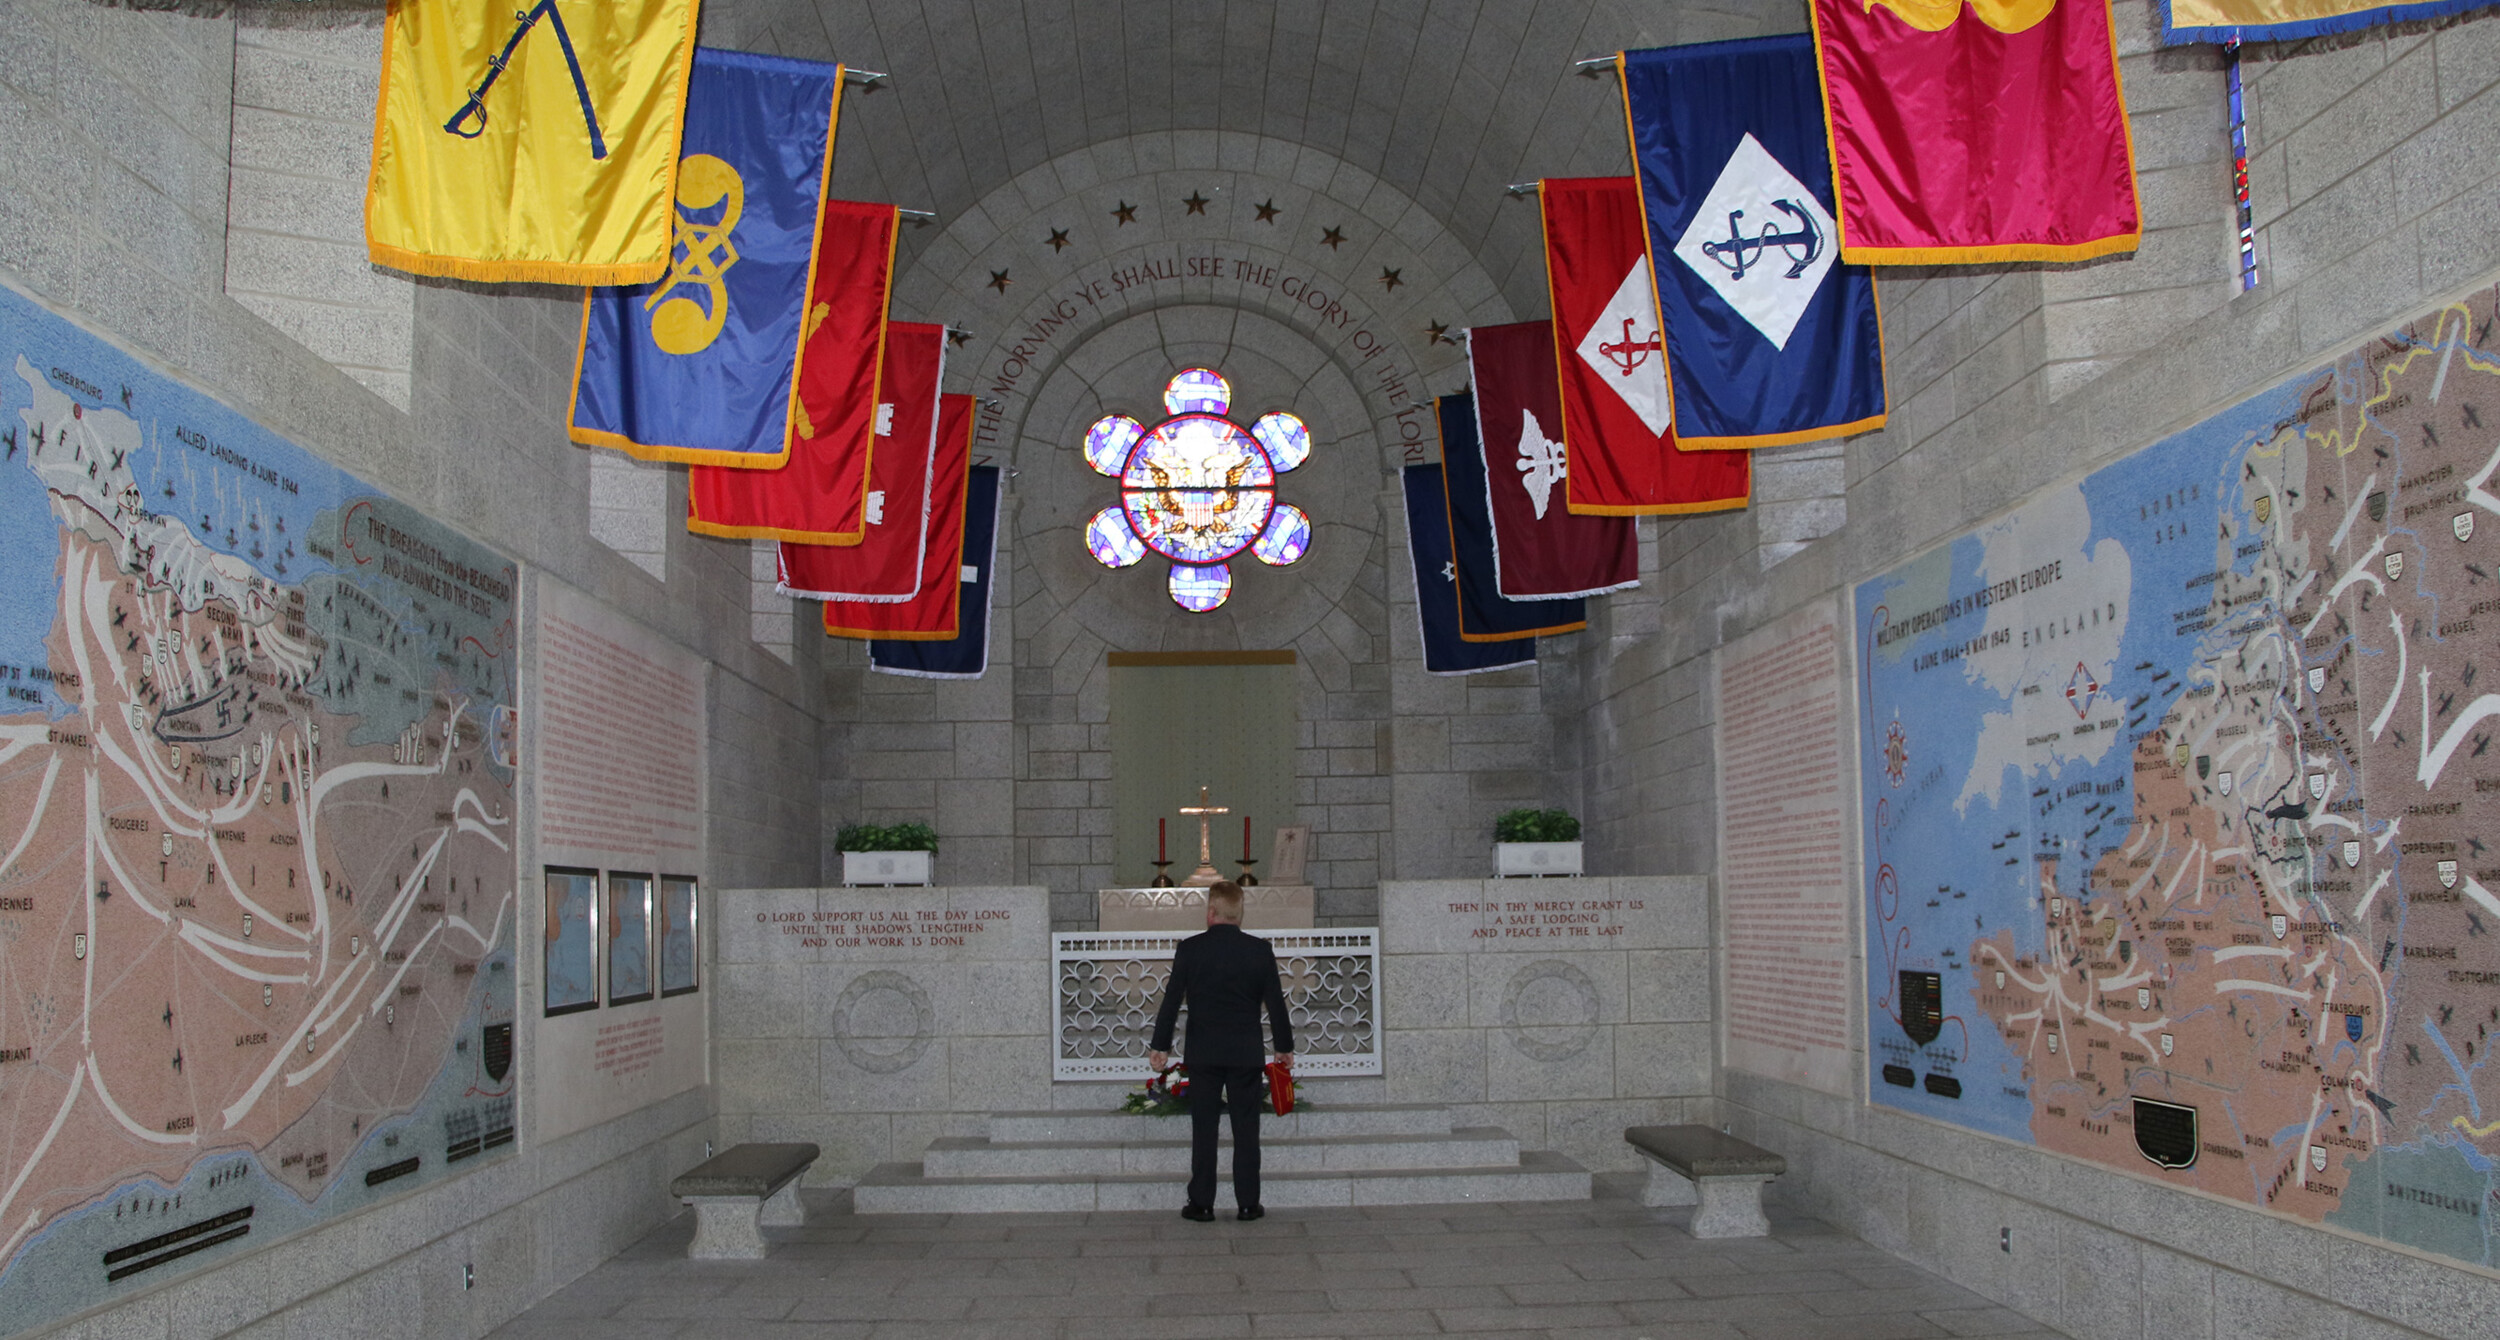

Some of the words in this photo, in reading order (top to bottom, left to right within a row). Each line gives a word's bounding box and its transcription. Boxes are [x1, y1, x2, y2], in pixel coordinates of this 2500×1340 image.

[975, 404, 1005, 444] THE
[991, 299, 1077, 399] MORNING
[1075, 281, 1110, 306] YE
[1111, 258, 1181, 292] SHALL
[1187, 257, 1225, 278] SEE
[1233, 259, 1277, 288] THE
[1281, 277, 1357, 329] GLORY
[1353, 330, 1386, 358] OF
[1376, 364, 1410, 406] THE
[52, 367, 103, 401] CHERBOURG
[2373, 395, 2412, 417] BREMEN
[176, 425, 207, 451] ALLIED
[210, 443, 249, 472] LANDING
[251, 459, 257, 473] 6
[257, 463, 278, 487] JUNE
[281, 476, 299, 496] 1944
[2400, 464, 2453, 490] HANNOVER
[2155, 522, 2187, 544] SEA
[368, 516, 387, 545] THE
[437, 553, 457, 577] from
[203, 579, 215, 596] BR
[382, 553, 401, 580] AND
[402, 563, 440, 598] ADVANCE
[454, 584, 469, 609] THE
[471, 590, 492, 620] SEINE
[1877, 618, 1910, 648] MILITARY
[1912, 599, 1962, 632] OPERATIONS
[1963, 596, 1974, 616] IN
[1975, 577, 2019, 608] WESTERN
[2020, 560, 2063, 593] EUROPE
[2233, 590, 2262, 606] ARNHEM
[206, 605, 236, 627] SECOND
[287, 606, 304, 625] FIRST
[2022, 602, 2116, 648] ENGLAND
[2439, 621, 2476, 637] KASSEL
[221, 624, 243, 644] ARMY
[1921, 651, 1939, 671] JUNE
[1972, 636, 1988, 653] MAY
[1990, 627, 2010, 647] 1945
[11, 666, 21, 679] ST
[30, 667, 80, 688] AVRANCHES
[8, 687, 43, 704] MICHEL
[2234, 680, 2278, 696] EINDHOVEN
[2319, 702, 2358, 716] COLOGNE
[2073, 723, 2095, 735] LONDON
[2216, 724, 2248, 738] BRUSSELS
[48, 730, 59, 743] ST
[61, 731, 88, 748] JAMES
[2066, 782, 2091, 798] ALLIED
[2409, 802, 2461, 815] FRANKFURT
[109, 816, 149, 832] FOUGERES
[216, 830, 245, 842] MAYENNE
[2402, 842, 2456, 855] OPPENHEIM
[2215, 863, 2236, 875] SEDAN
[0, 897, 33, 911] RENNES
[174, 896, 196, 909] LAVAL
[1448, 903, 1479, 913] THEN
[1486, 903, 1499, 912] IN
[1505, 902, 1528, 912] THY
[1534, 901, 1576, 911] MERCY
[1582, 900, 1622, 910] GRANT
[1629, 900, 1644, 910] US
[757, 913, 766, 922] O
[772, 912, 805, 923] LORD
[811, 911, 863, 923] SUPPORT
[869, 911, 884, 922] US
[890, 911, 909, 921] ALL
[916, 910, 938, 921] THE
[945, 910, 968, 921] DAY
[974, 910, 1011, 920] LONG
[1495, 916, 1503, 925] A
[1510, 914, 1535, 924] SAFE
[1543, 913, 1599, 924] LODGING
[782, 925, 817, 935] UNTIL
[824, 924, 845, 934] THE
[855, 923, 913, 934] SHADOWS
[920, 923, 985, 934] LENGTHEN
[1472, 929, 1498, 938] AND
[1505, 928, 1541, 938] PEACE
[1549, 927, 1562, 937] AT
[1569, 927, 1589, 937] THE
[1597, 926, 1624, 936] LAST
[801, 937, 827, 948] AND
[835, 937, 860, 947] OUR
[867, 936, 904, 947] WORK
[911, 936, 922, 946] IS
[930, 936, 965, 946] DONE
[2232, 932, 2258, 944] VERDUN
[2303, 935, 2324, 946] METZ
[2321, 1002, 2371, 1015] STRASBOURG
[2287, 1018, 2313, 1031] NANCY
[236, 1037, 245, 1047] LA
[246, 1032, 268, 1046] FLECHE
[2282, 1051, 2311, 1065] EPINAL
[2321, 1075, 2355, 1089] COLMAR
[166, 1115, 195, 1132] ANGERS
[2244, 1134, 2269, 1148] DIJON
[2321, 1134, 2367, 1151] MULHOUSE
[2267, 1159, 2296, 1202] SAONE
[2305, 1180, 2338, 1197] BELFORT
[2387, 1183, 2479, 1217] SWITZERLAND
